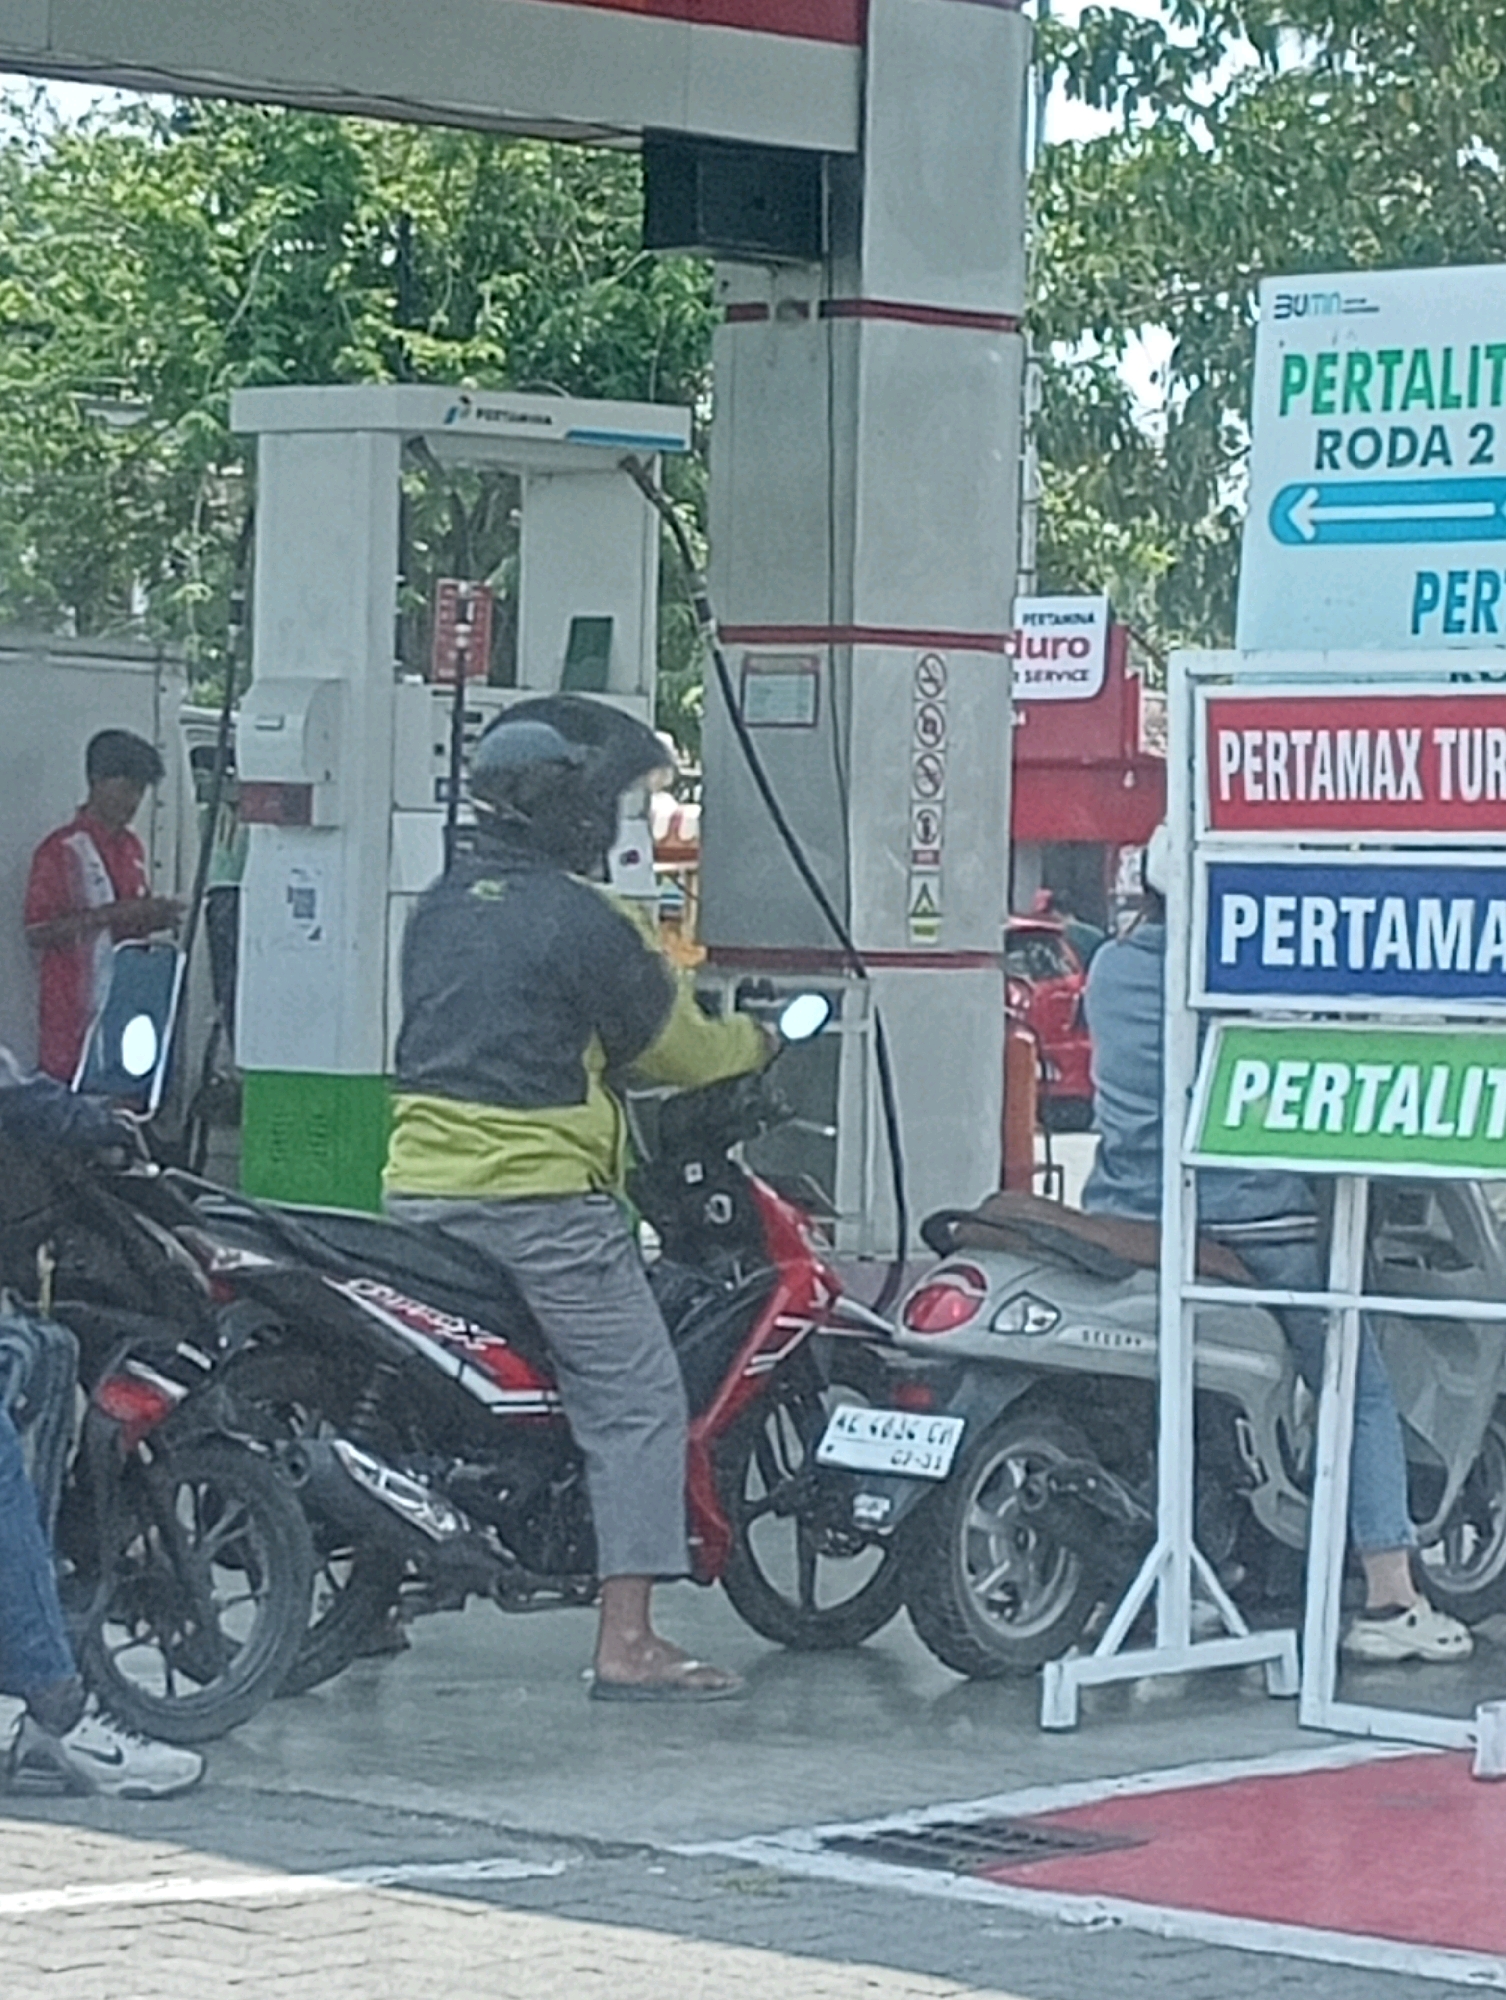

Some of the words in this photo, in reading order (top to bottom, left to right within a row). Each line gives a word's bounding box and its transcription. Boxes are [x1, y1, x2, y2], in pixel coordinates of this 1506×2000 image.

[1279, 343, 1506, 416] PERTALIT
[1315, 424, 1452, 470] RODA
[1468, 422, 1495, 466] 2
[1022, 612, 1095, 626] PERTAMINA
[1411, 569, 1506, 635] PER
[1025, 669, 1090, 683] SERVICE
[1217, 728, 1422, 802] PERTAMAX
[1432, 727, 1506, 803] TUR
[1220, 893, 1506, 974] PERTAMA
